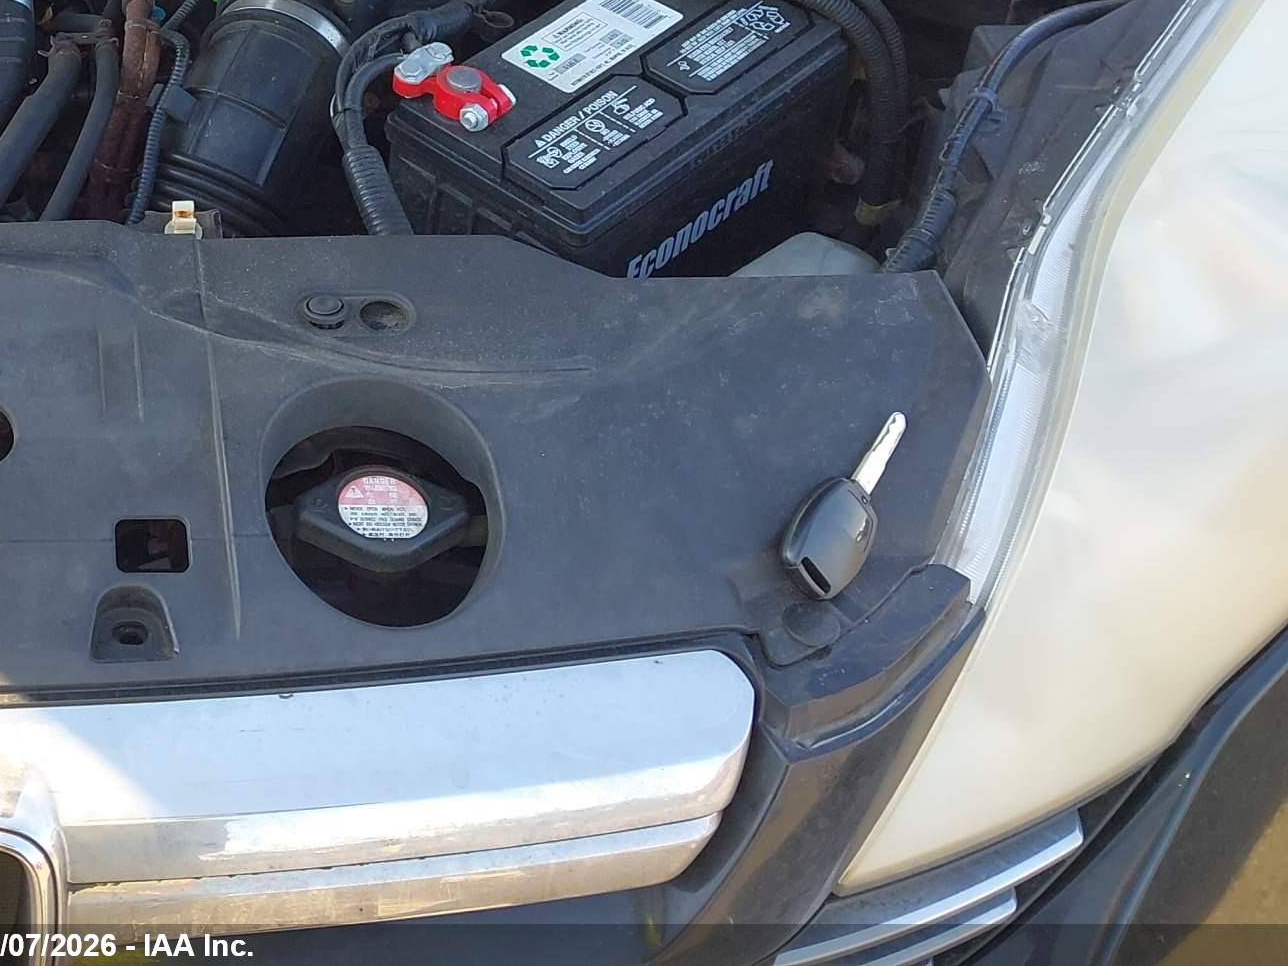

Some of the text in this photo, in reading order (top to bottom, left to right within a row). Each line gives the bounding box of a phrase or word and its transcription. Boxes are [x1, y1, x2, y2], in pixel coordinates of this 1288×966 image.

[541, 115, 580, 143] DANGER
[585, 90, 620, 115] POISON
[626, 158, 774, 281] Econocraft
